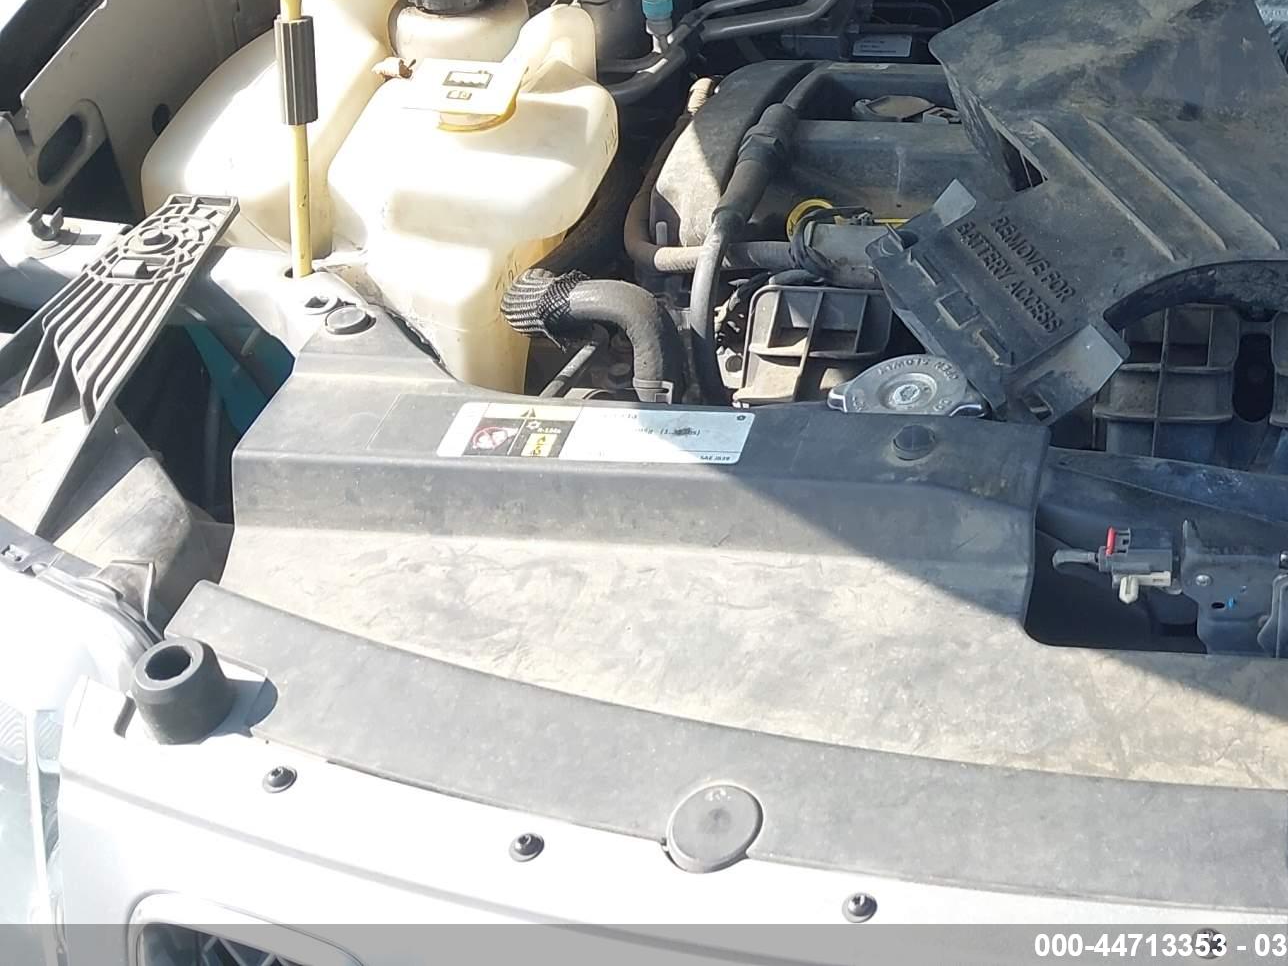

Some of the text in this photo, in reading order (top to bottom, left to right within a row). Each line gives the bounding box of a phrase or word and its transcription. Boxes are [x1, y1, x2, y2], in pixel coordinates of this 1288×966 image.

[957, 221, 1063, 334] BATTERY ACCESS
[990, 216, 1077, 304] REMOVE FOR
